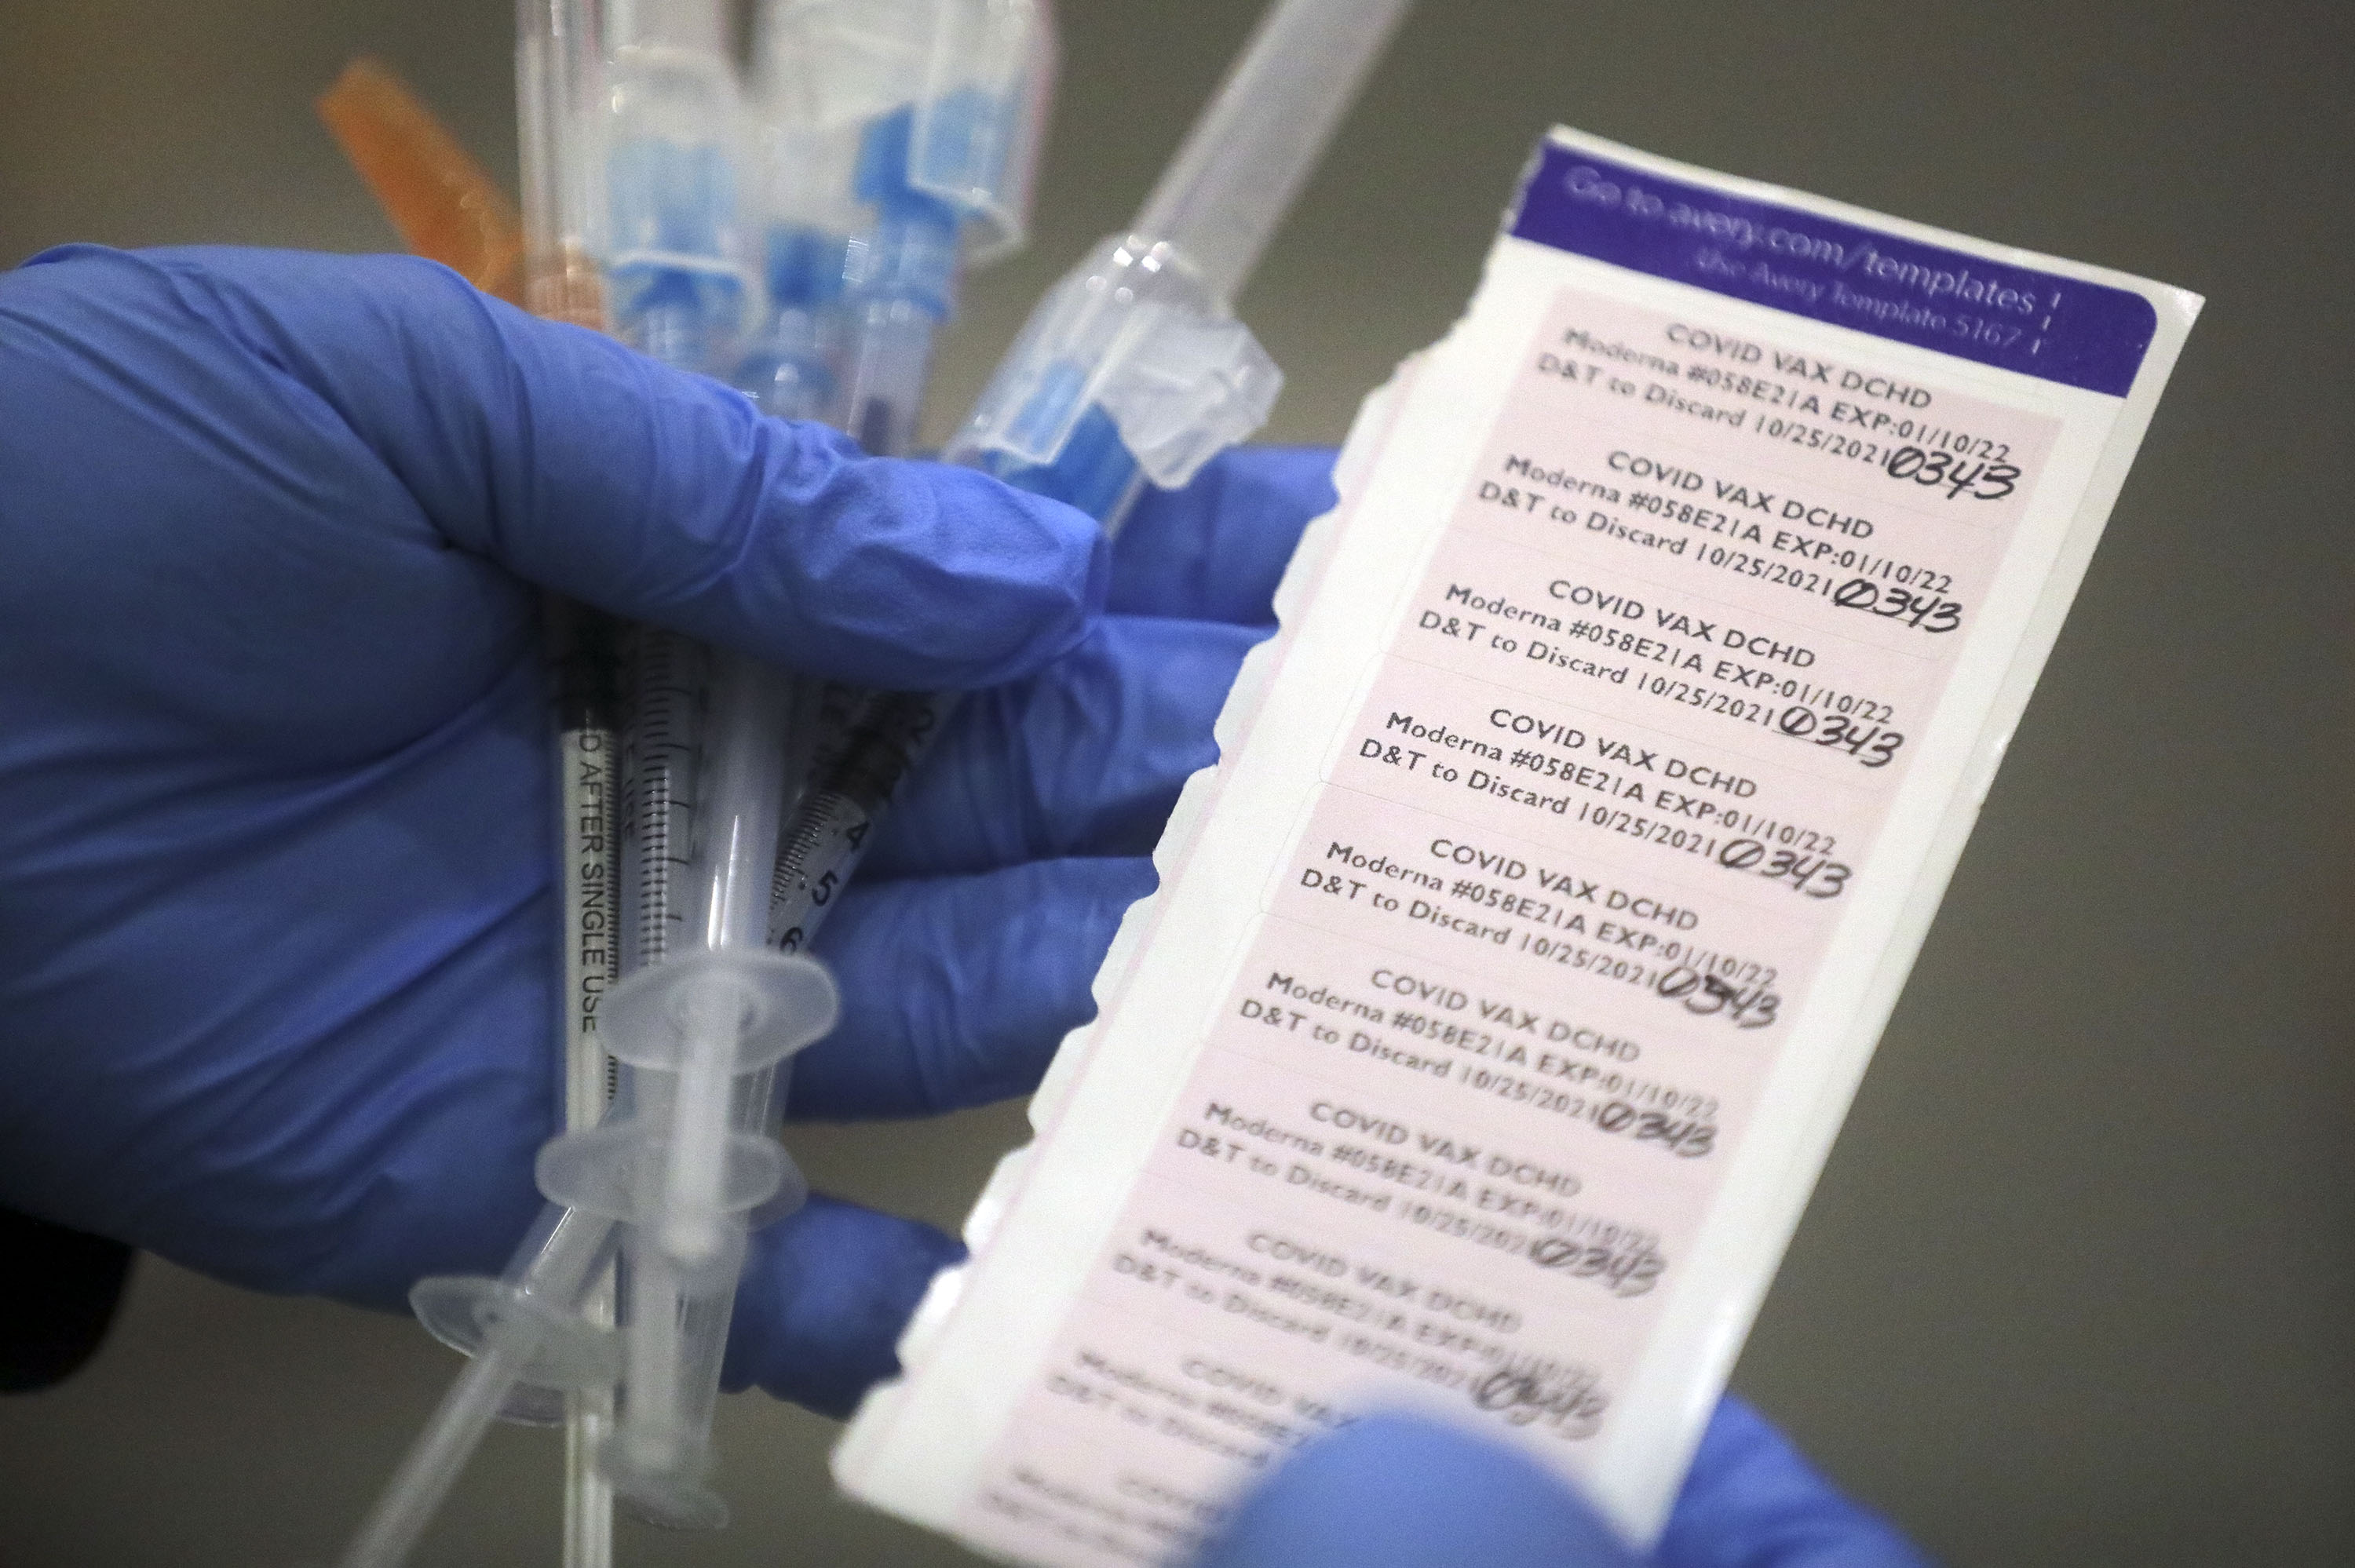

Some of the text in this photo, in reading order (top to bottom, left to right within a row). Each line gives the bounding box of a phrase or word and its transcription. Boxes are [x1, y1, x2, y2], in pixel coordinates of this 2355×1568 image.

[1561, 164, 2036, 315] Go to avery.com/templates
[1665, 323, 1933, 410] COVID VAX DCHD
[1952, 314, 2022, 348] 5167
[1535, 353, 1896, 470] D&T to Discard 10/25/2021
[1561, 327, 2011, 467] Moderna #058E21A EXP:01/10/22
[1605, 450, 1875, 539] COVID VAX DCHD
[1886, 444, 2021, 501] 0343
[1477, 480, 1835, 596] D&T to Discard 10/25/2021
[1502, 454, 1953, 595] Moderna #058E21A EXP:01/10/22
[1547, 579, 1816, 669] COVID VAX DCHD
[1832, 577, 1962, 633] 0343
[1418, 610, 1775, 726] D&T to Discard 10/25/2021
[1444, 583, 1895, 724] Moderna #058E21A EXP:01/10/22
[1385, 712, 1838, 855] Moderna #058E21A EXP:01/10/22
[1488, 708, 1758, 798] COVID VAX DCHD
[1777, 706, 1904, 768] 0343
[580, 759, 604, 854] AFTER
[1358, 738, 1718, 857] D&T to Discard 10/25/2021
[1324, 841, 1779, 987] Moderna #058E21A EXP:01/10/22
[1428, 837, 1700, 931] COVID VAX DCHD
[1716, 837, 1852, 899] 0343
[581, 862, 605, 968] SINGLE
[1298, 868, 1663, 990] D&T to Discard 10/25/2021
[582, 975, 604, 1034] USE
[1238, 998, 1307, 1032] D&T
[1310, 1022, 1342, 1045] to
[1346, 1030, 1453, 1078] Discard
[1264, 972, 1386, 1023] Moderna
[1389, 1010, 1530, 1065] #058E21A
[1368, 968, 1642, 1063] COVID VAX DCHD
[1175, 1128, 1244, 1162] D&T
[1247, 1153, 1280, 1176] to
[1283, 1163, 1393, 1212] Discard
[1201, 1102, 1327, 1156] Moderna
[1593, 1099, 1716, 1158] 0343
